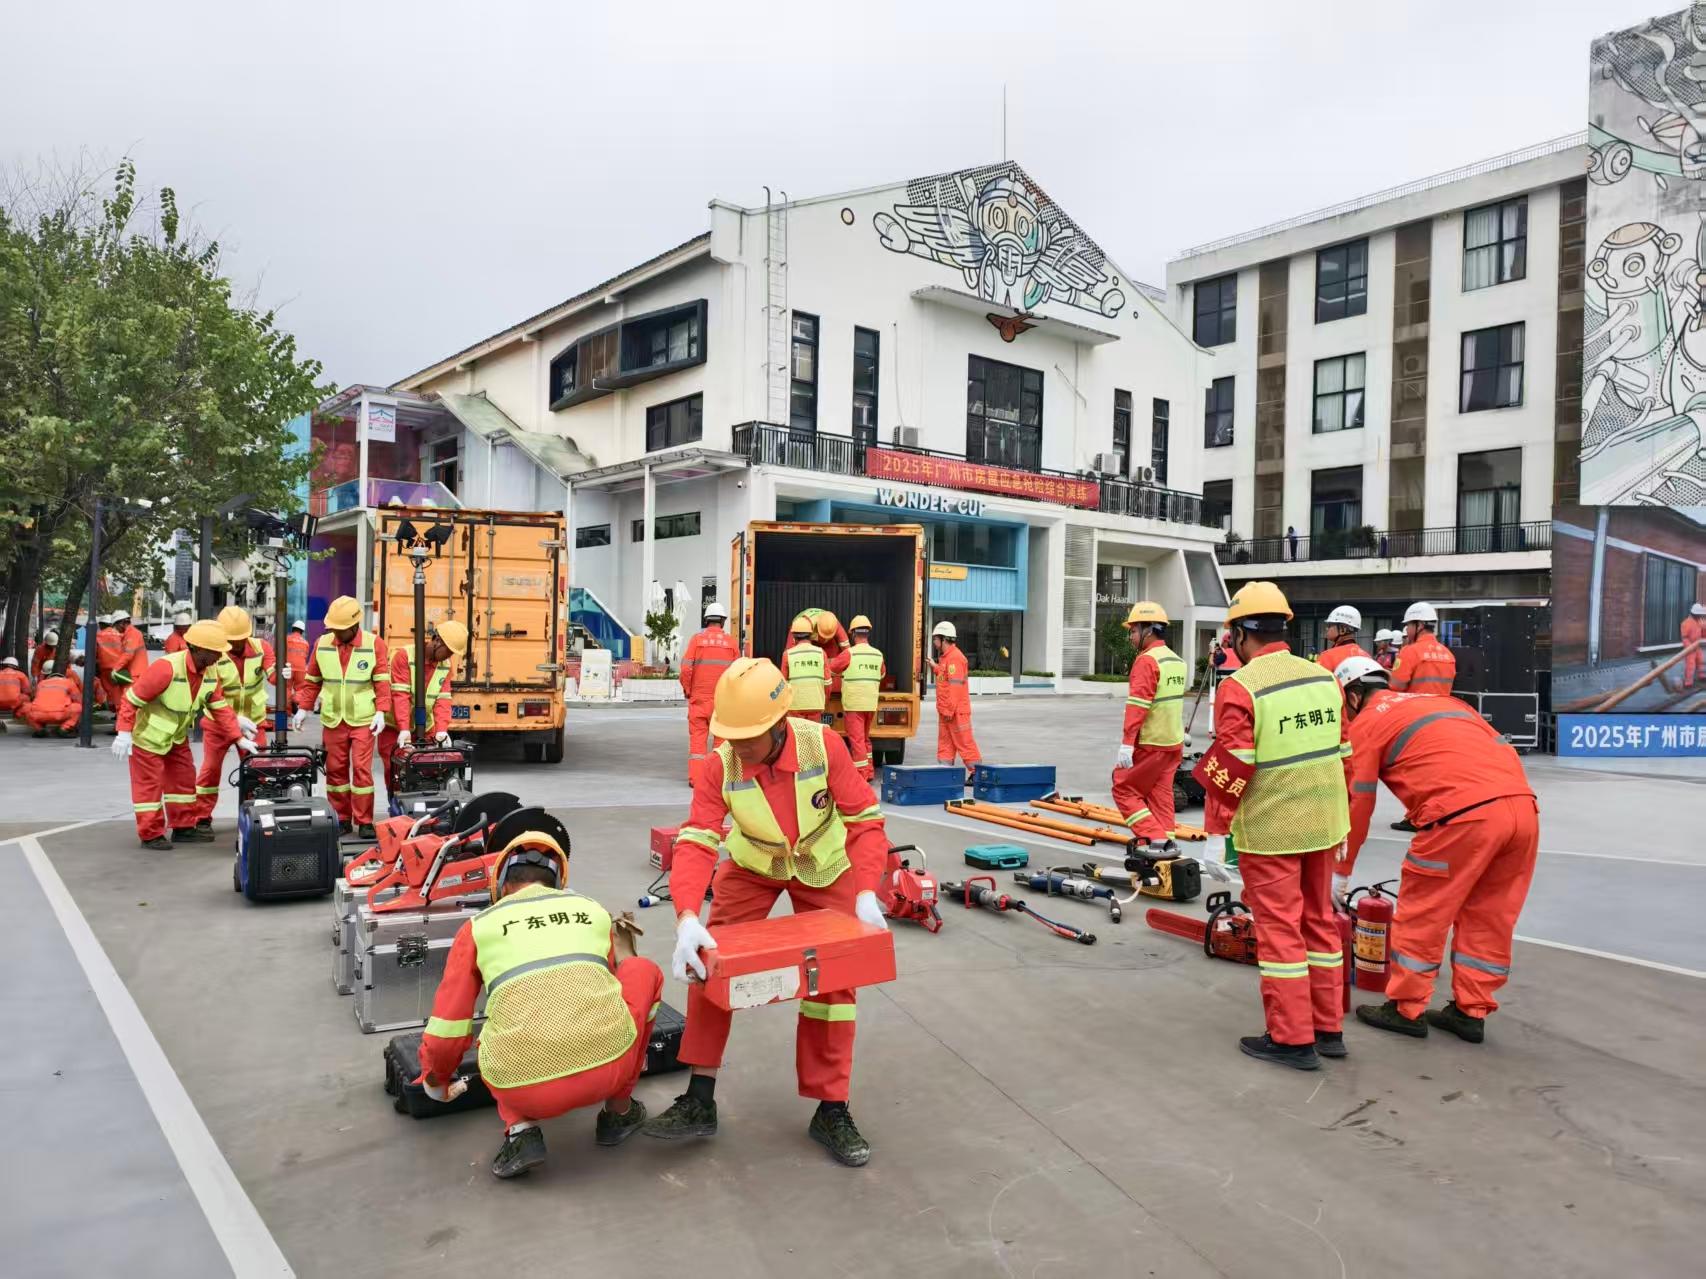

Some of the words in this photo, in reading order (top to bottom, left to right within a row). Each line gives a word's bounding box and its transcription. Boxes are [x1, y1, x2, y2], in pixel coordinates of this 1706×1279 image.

[883, 455, 1088, 502] 2025年广州市房屋应急抢险综合演练
[878, 488, 950, 513] WONDER
[957, 500, 987, 517] CUP
[1278, 707, 1337, 735] 广东明龙
[1203, 755, 1247, 798] 安全员
[502, 912, 593, 936] 广东明龙
